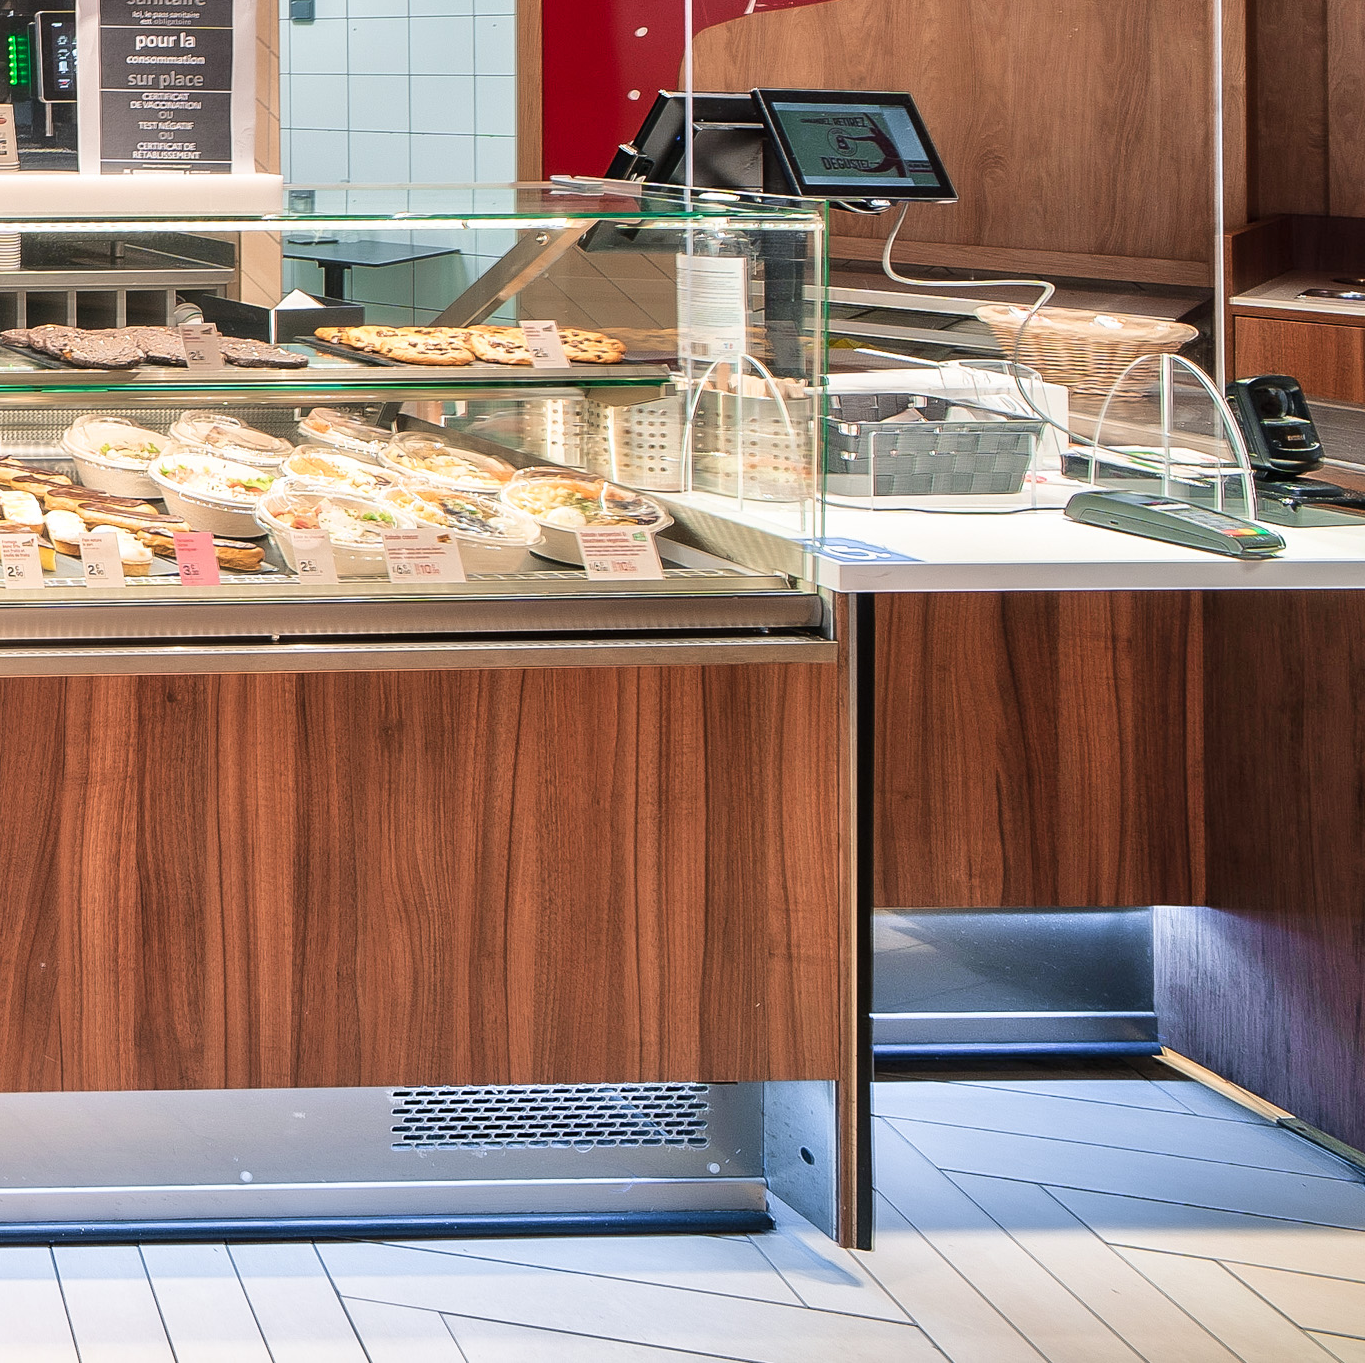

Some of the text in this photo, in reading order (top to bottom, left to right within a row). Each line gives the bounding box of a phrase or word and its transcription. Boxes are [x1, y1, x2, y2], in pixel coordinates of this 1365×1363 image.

[135, 33, 195, 50] pour la
[126, 54, 205, 65] consommation
[127, 71, 204, 88] sur place
[158, 111, 173, 119] OU
